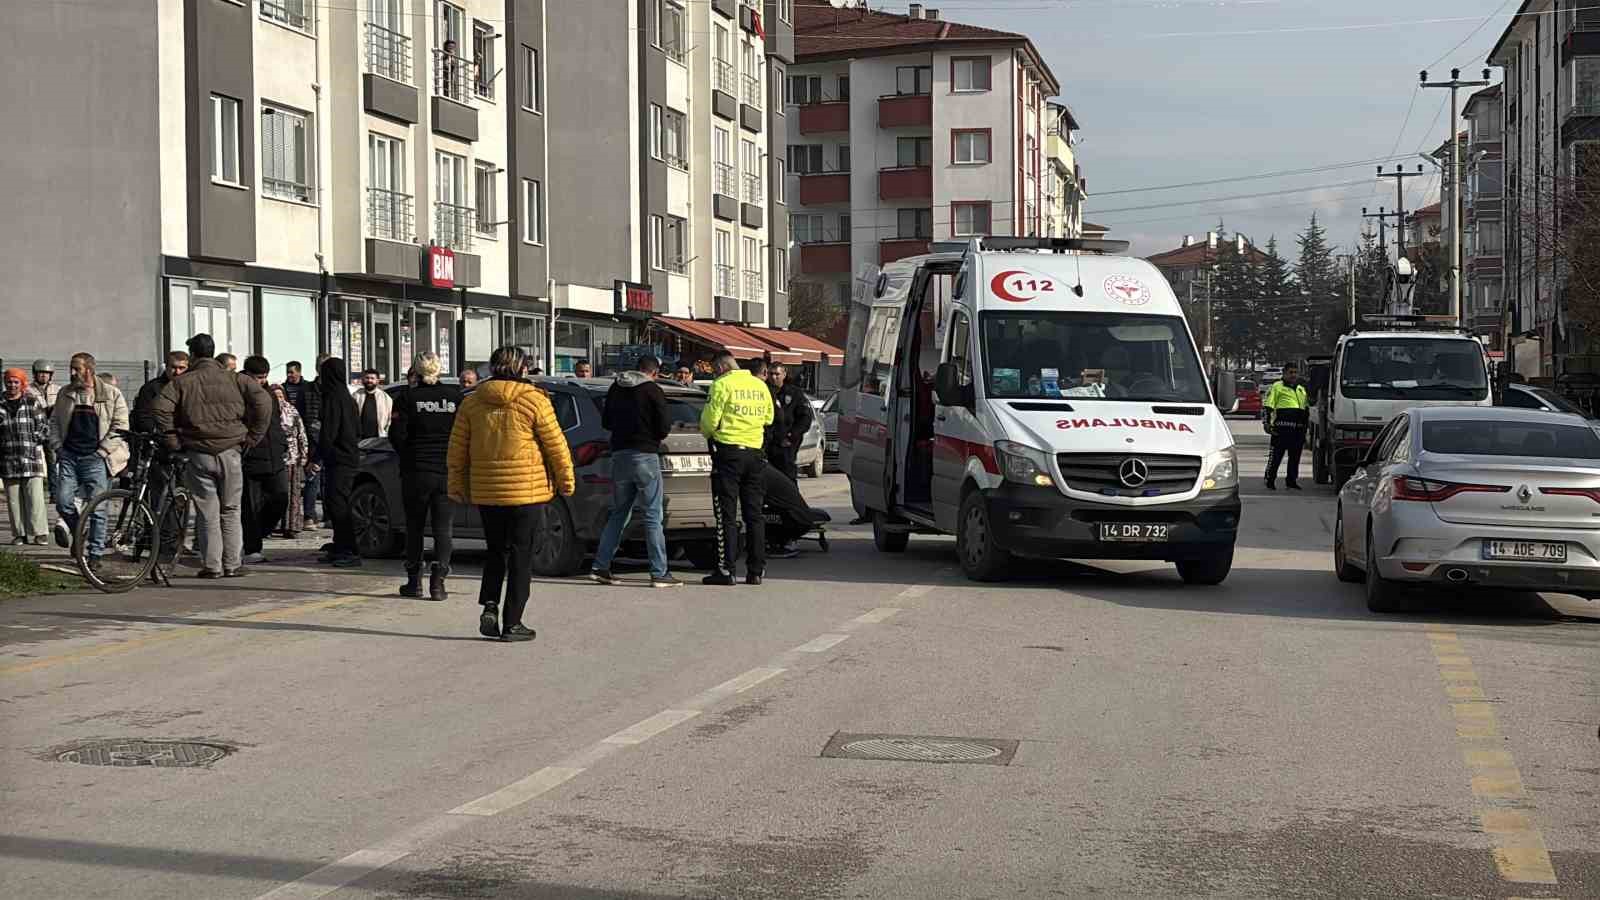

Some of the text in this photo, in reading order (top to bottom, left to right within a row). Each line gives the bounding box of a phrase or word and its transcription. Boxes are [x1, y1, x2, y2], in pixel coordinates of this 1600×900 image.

[1012, 279, 1054, 292] 112
[1104, 524, 1167, 537] 14 DR 732
[1492, 541, 1506, 555] 14
[1542, 543, 1564, 557] 709
